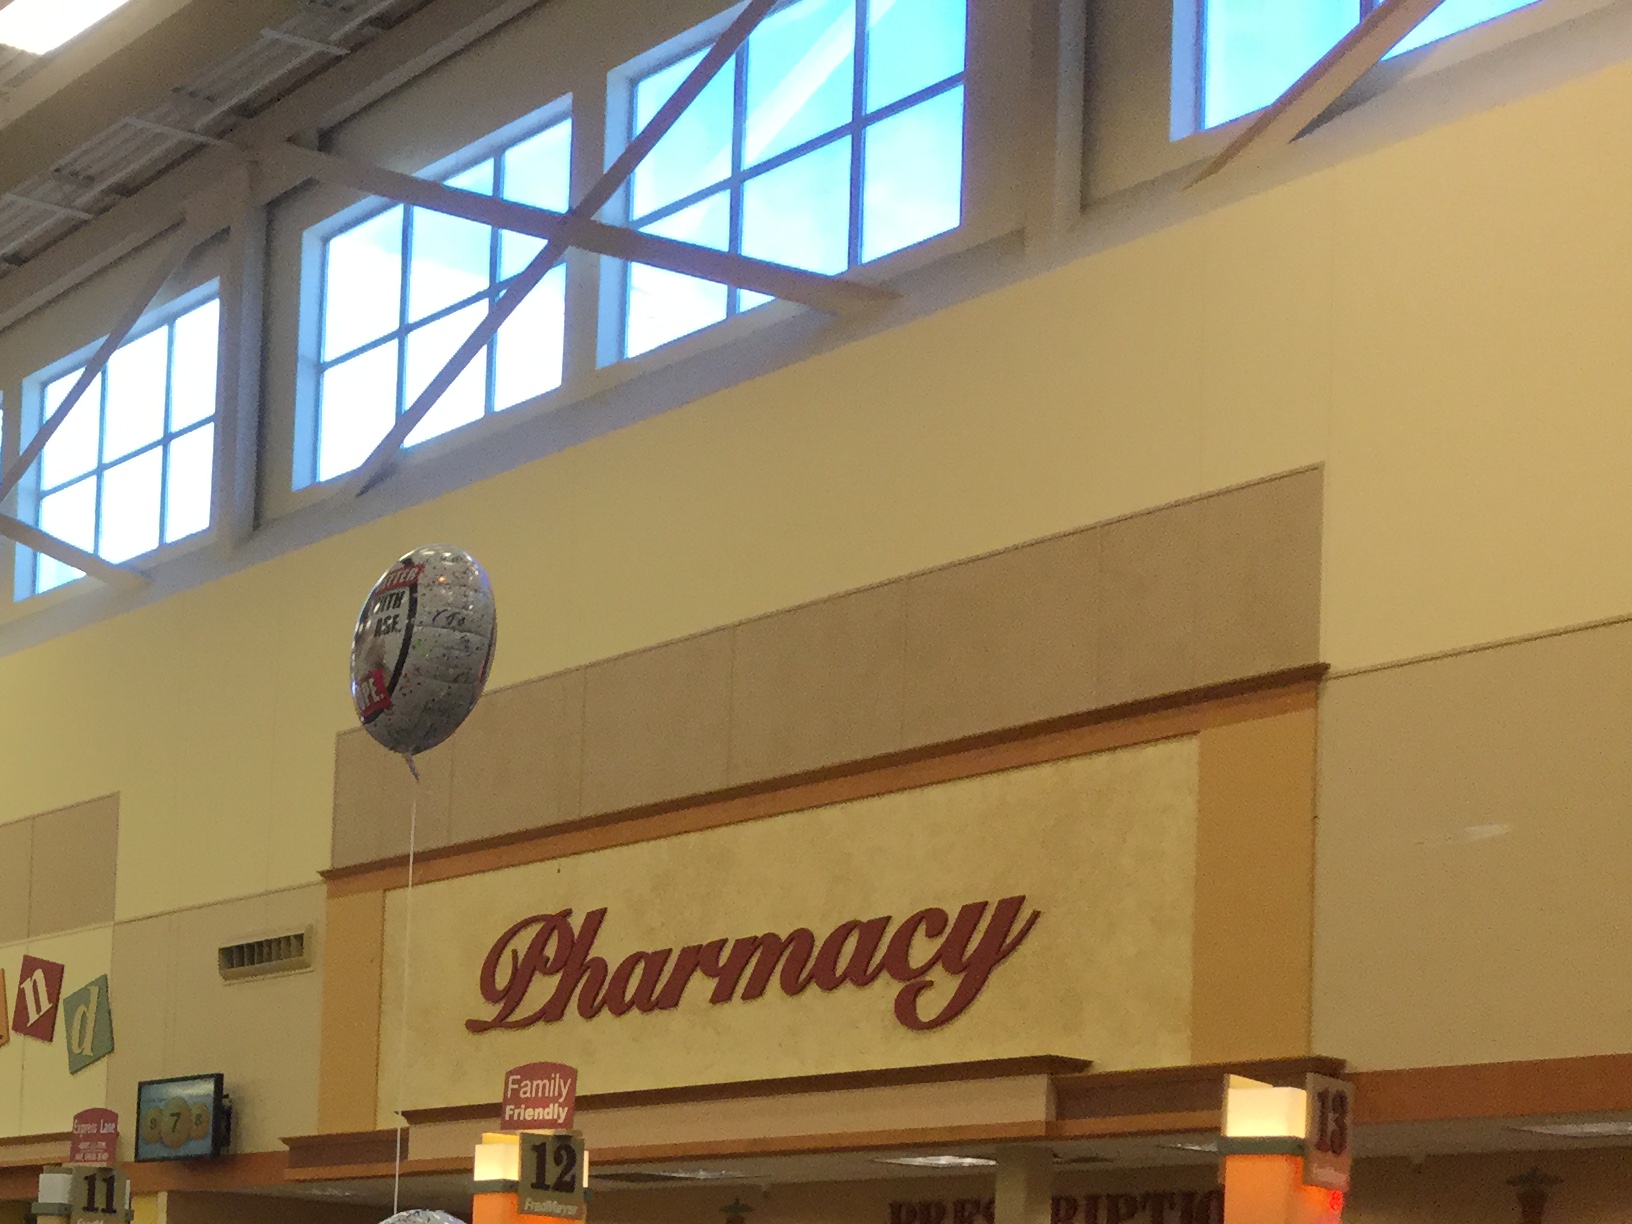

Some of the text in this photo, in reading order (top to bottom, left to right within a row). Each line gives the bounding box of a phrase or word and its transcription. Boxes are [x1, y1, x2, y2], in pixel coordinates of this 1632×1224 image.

[464, 894, 1042, 1034] Pharmacy
[507, 1072, 572, 1103] Family
[73, 1118, 116, 1138] Express Lane
[170, 1112, 182, 1133] 7
[504, 1103, 569, 1124] Friendly
[1316, 1087, 1348, 1156] 13
[530, 1142, 578, 1194] 12
[83, 1173, 117, 1214] 11
